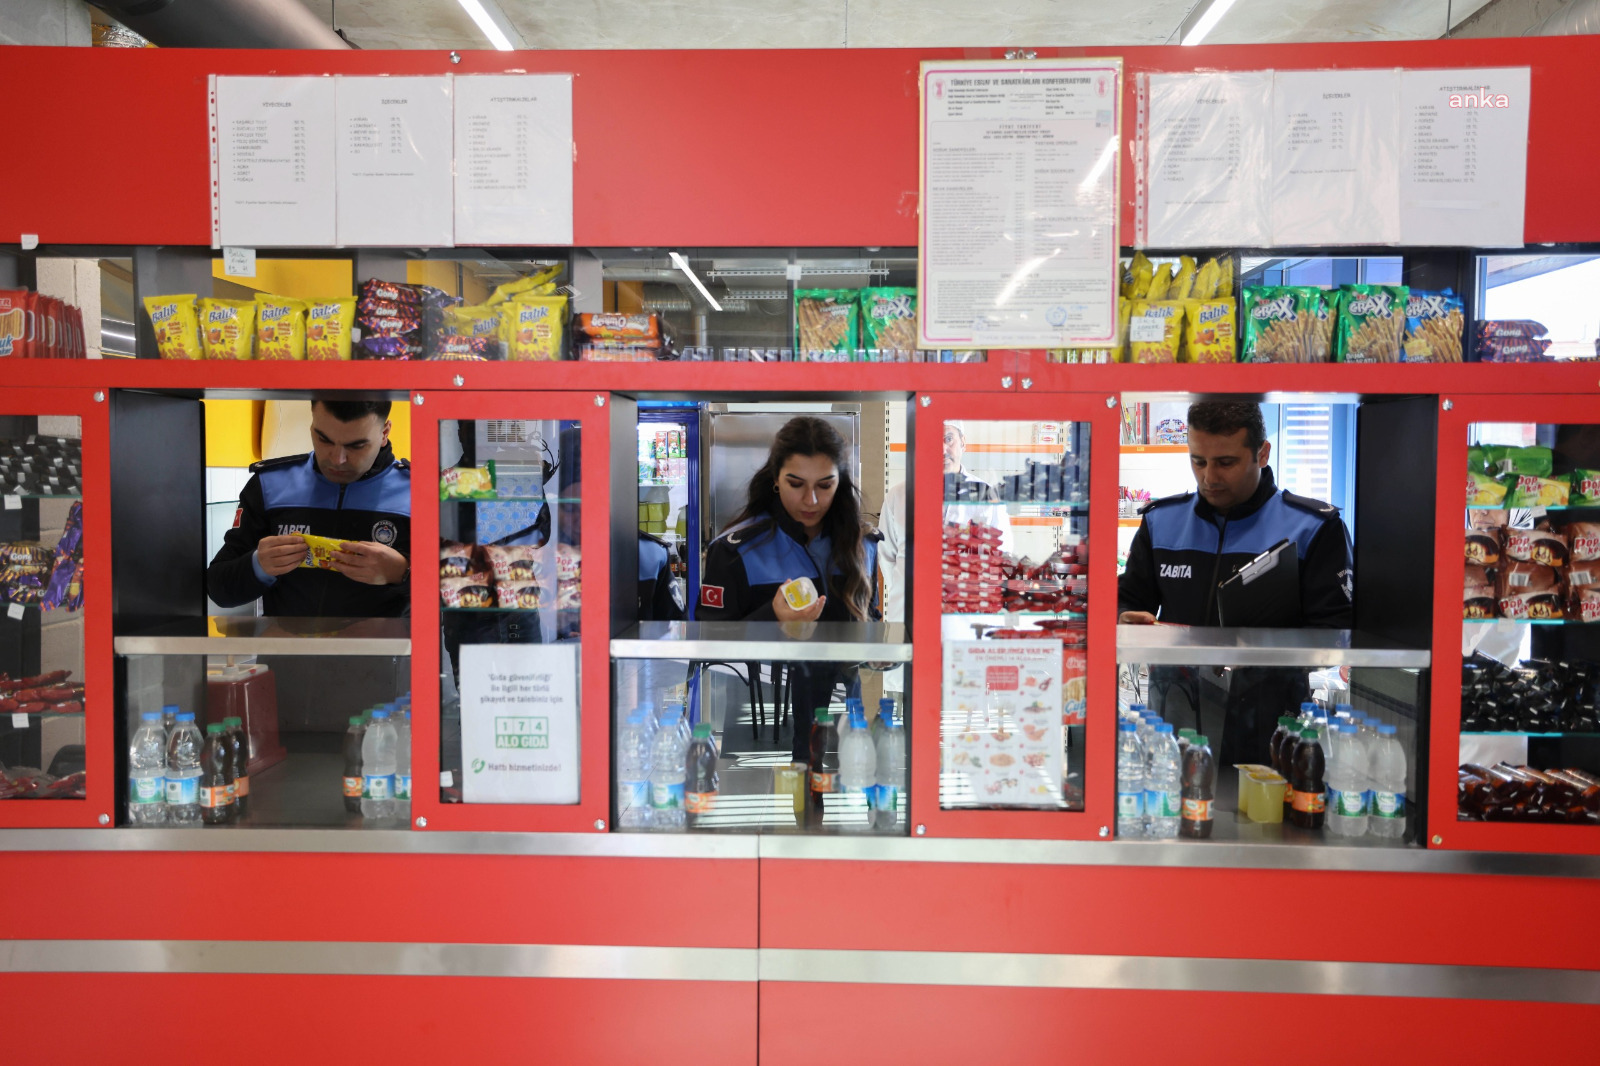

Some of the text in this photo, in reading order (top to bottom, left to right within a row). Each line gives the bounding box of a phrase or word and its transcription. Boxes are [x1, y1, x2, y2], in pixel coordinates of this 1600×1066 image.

[951, 79, 972, 88] TÜRKİYE
[974, 79, 991, 88] ESNAF
[993, 79, 1000, 87] VE
[1042, 77, 1092, 86] KONFEDERASYONU
[376, 288, 399, 301] Gong
[871, 295, 915, 319] CRAX
[1254, 295, 1298, 322] CRAX
[1348, 291, 1393, 319] CRAX
[1405, 296, 1448, 319] CRAX
[376, 307, 398, 317] Gong
[519, 306, 549, 324] Balık
[1199, 304, 1230, 324] Balık
[380, 320, 403, 329] Gong
[1496, 328, 1521, 337] Gong
[1502, 345, 1528, 354] Gong
[1515, 474, 1539, 490] Pop
[1575, 537, 1599, 550] Pop
[1160, 563, 1192, 579] ZABITA
[1500, 599, 1523, 614] Pop
[518, 696, 549, 704] talebiniz
[550, 696, 564, 705] için
[518, 722, 526, 731] 7
[536, 721, 543, 731] 4
[497, 736, 548, 748] ALO GIDA
[510, 763, 562, 772] hizmetinizde!
